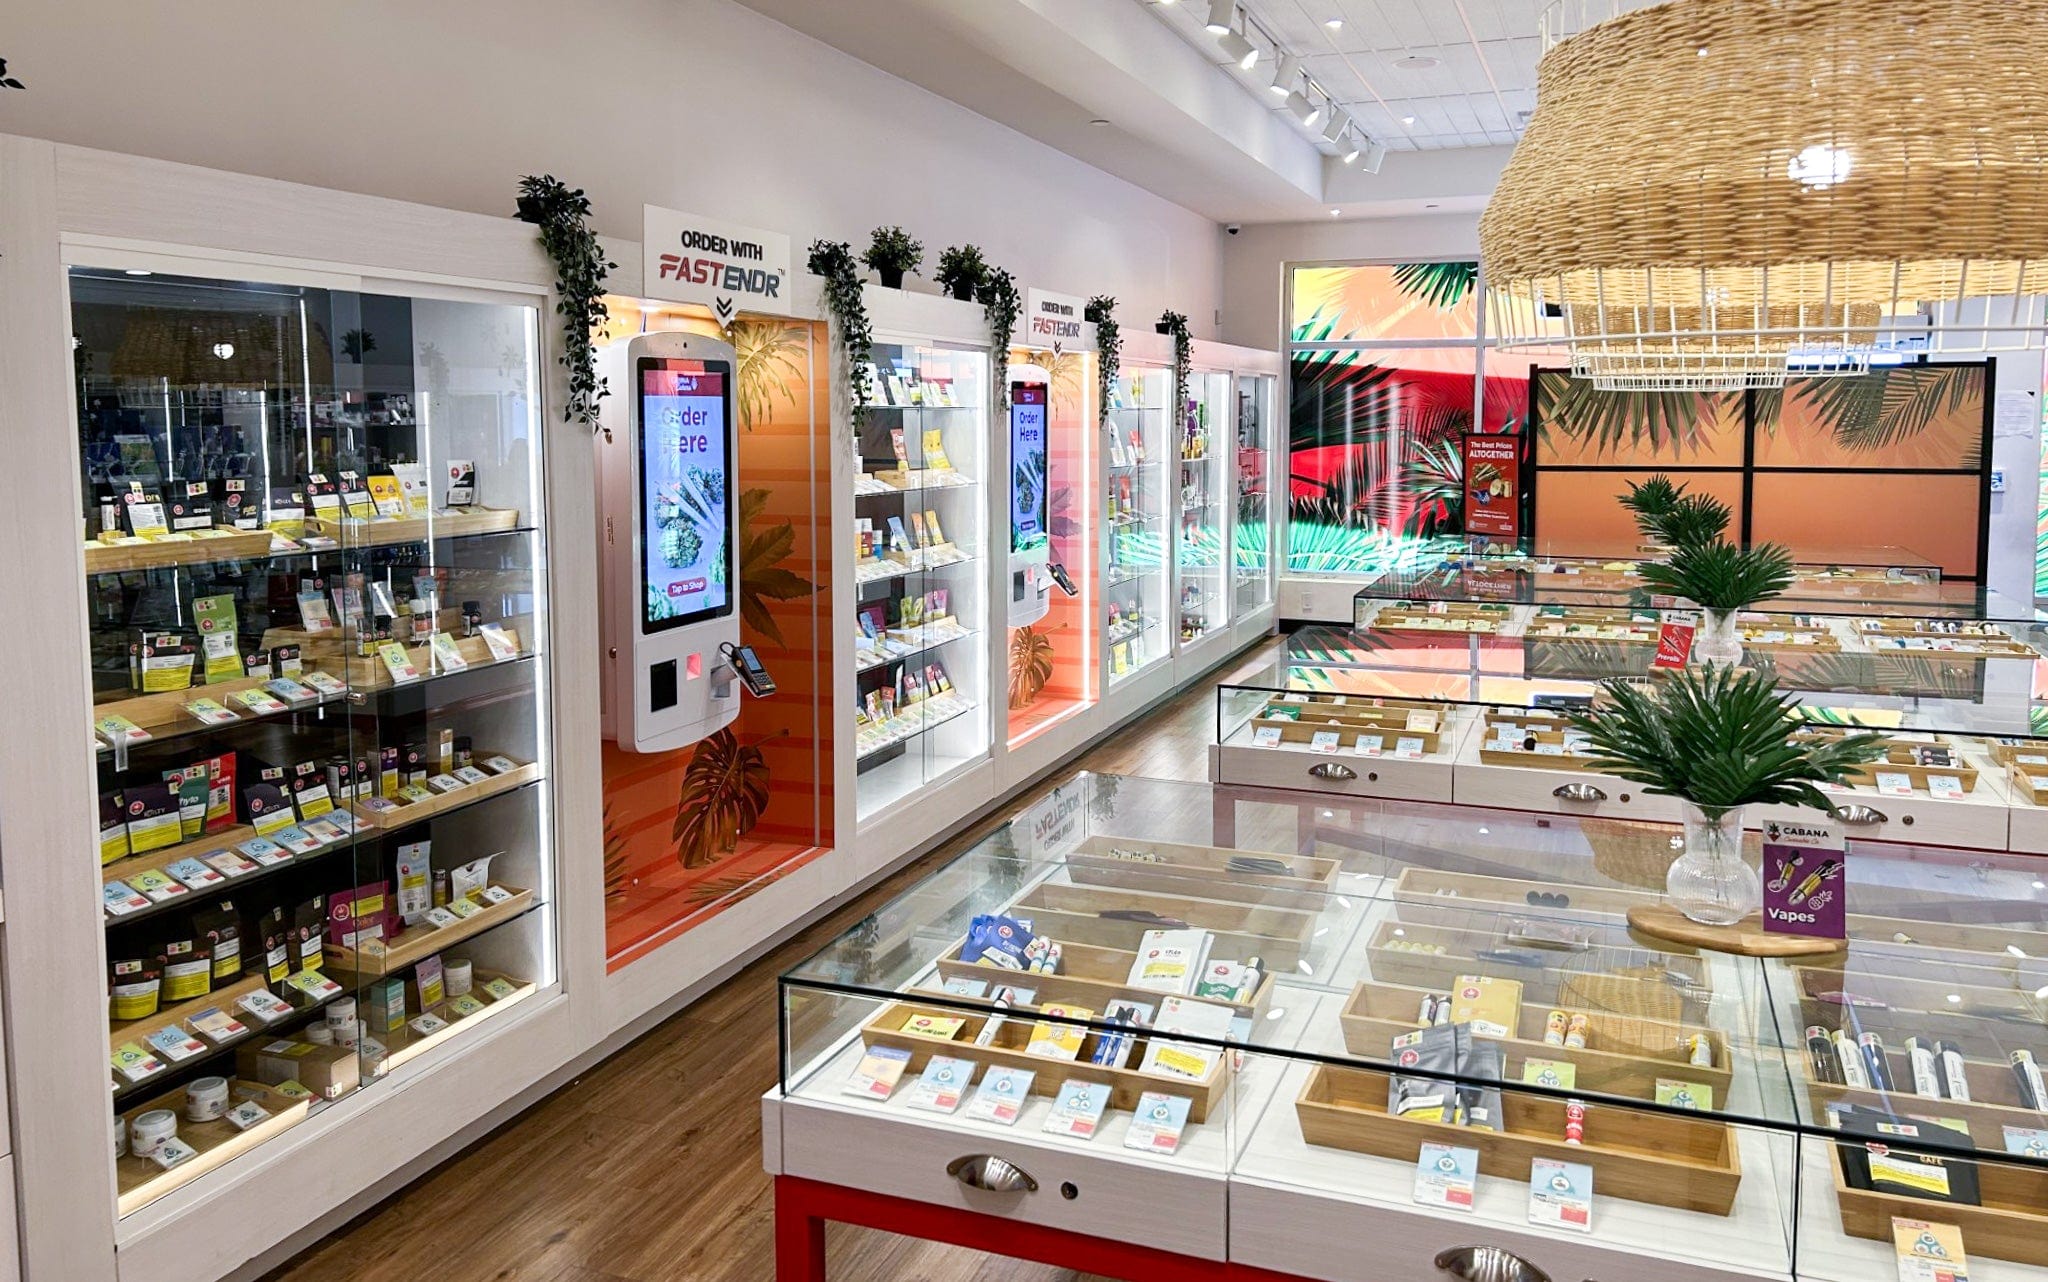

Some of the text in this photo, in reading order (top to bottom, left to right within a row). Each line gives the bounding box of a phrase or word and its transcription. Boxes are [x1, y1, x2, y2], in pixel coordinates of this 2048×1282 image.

[681, 230, 763, 261] ORDER WITH
[660, 254, 780, 298] FASTENDR
[1041, 301, 1074, 316] ORDER WITH
[1033, 317, 1080, 337] FASTENDR
[1020, 411, 1038, 424] Order
[1020, 426, 1038, 442] Here
[1470, 441, 1481, 449] The
[1469, 449, 1515, 460] ALTOGETHER
[671, 585, 682, 595] Tap
[688, 581, 704, 591] Shop
[1783, 827, 1829, 838] CABANA
[1768, 907, 1816, 923] Vapes
